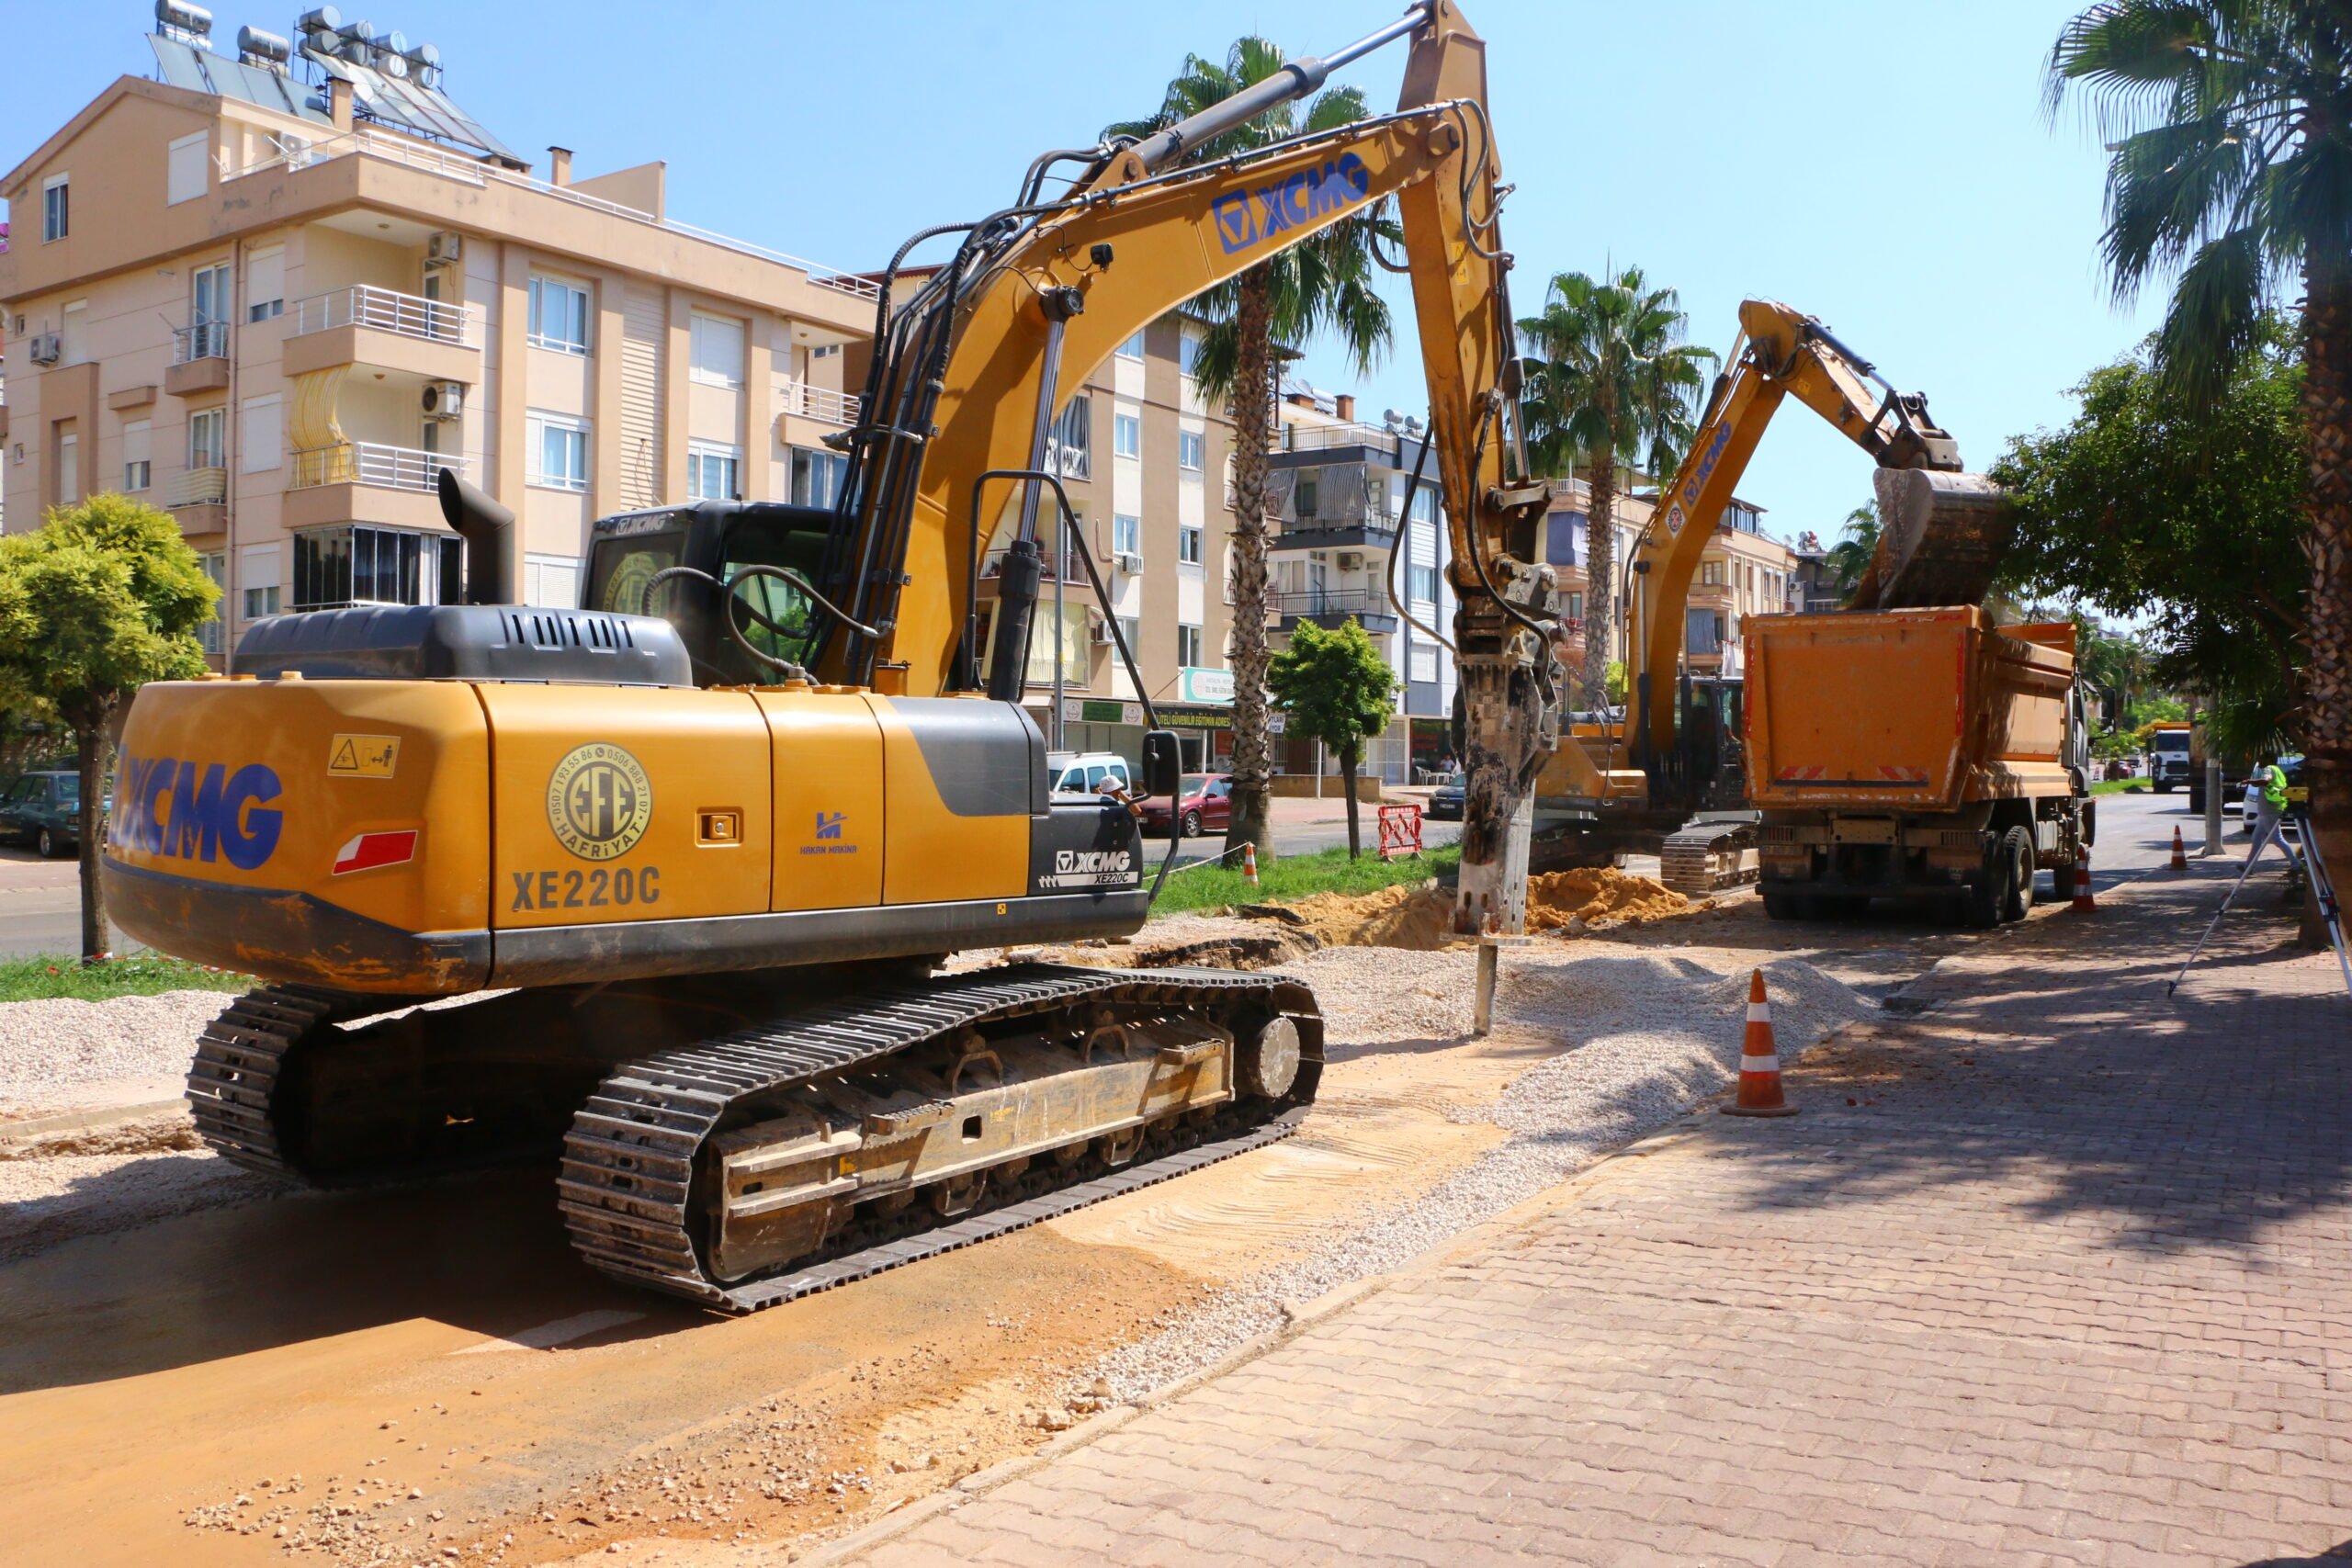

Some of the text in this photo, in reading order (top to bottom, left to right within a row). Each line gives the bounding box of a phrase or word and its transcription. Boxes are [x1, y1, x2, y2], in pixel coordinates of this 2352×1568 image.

[1255, 152, 1369, 240] XCMG
[1695, 420, 1732, 487] XCMG
[629, 513, 667, 534] XCMG
[552, 749, 593, 816] 0507 193 55 86
[607, 749, 629, 768] 0506
[628, 765, 644, 784] 888
[119, 757, 283, 871] XCMG
[569, 766, 631, 838] EFE
[800, 845, 826, 855] HAKAN
[1072, 851, 1130, 873] XCMG
[513, 866, 661, 912] XE220C
[1094, 873, 1129, 885] XE220C
